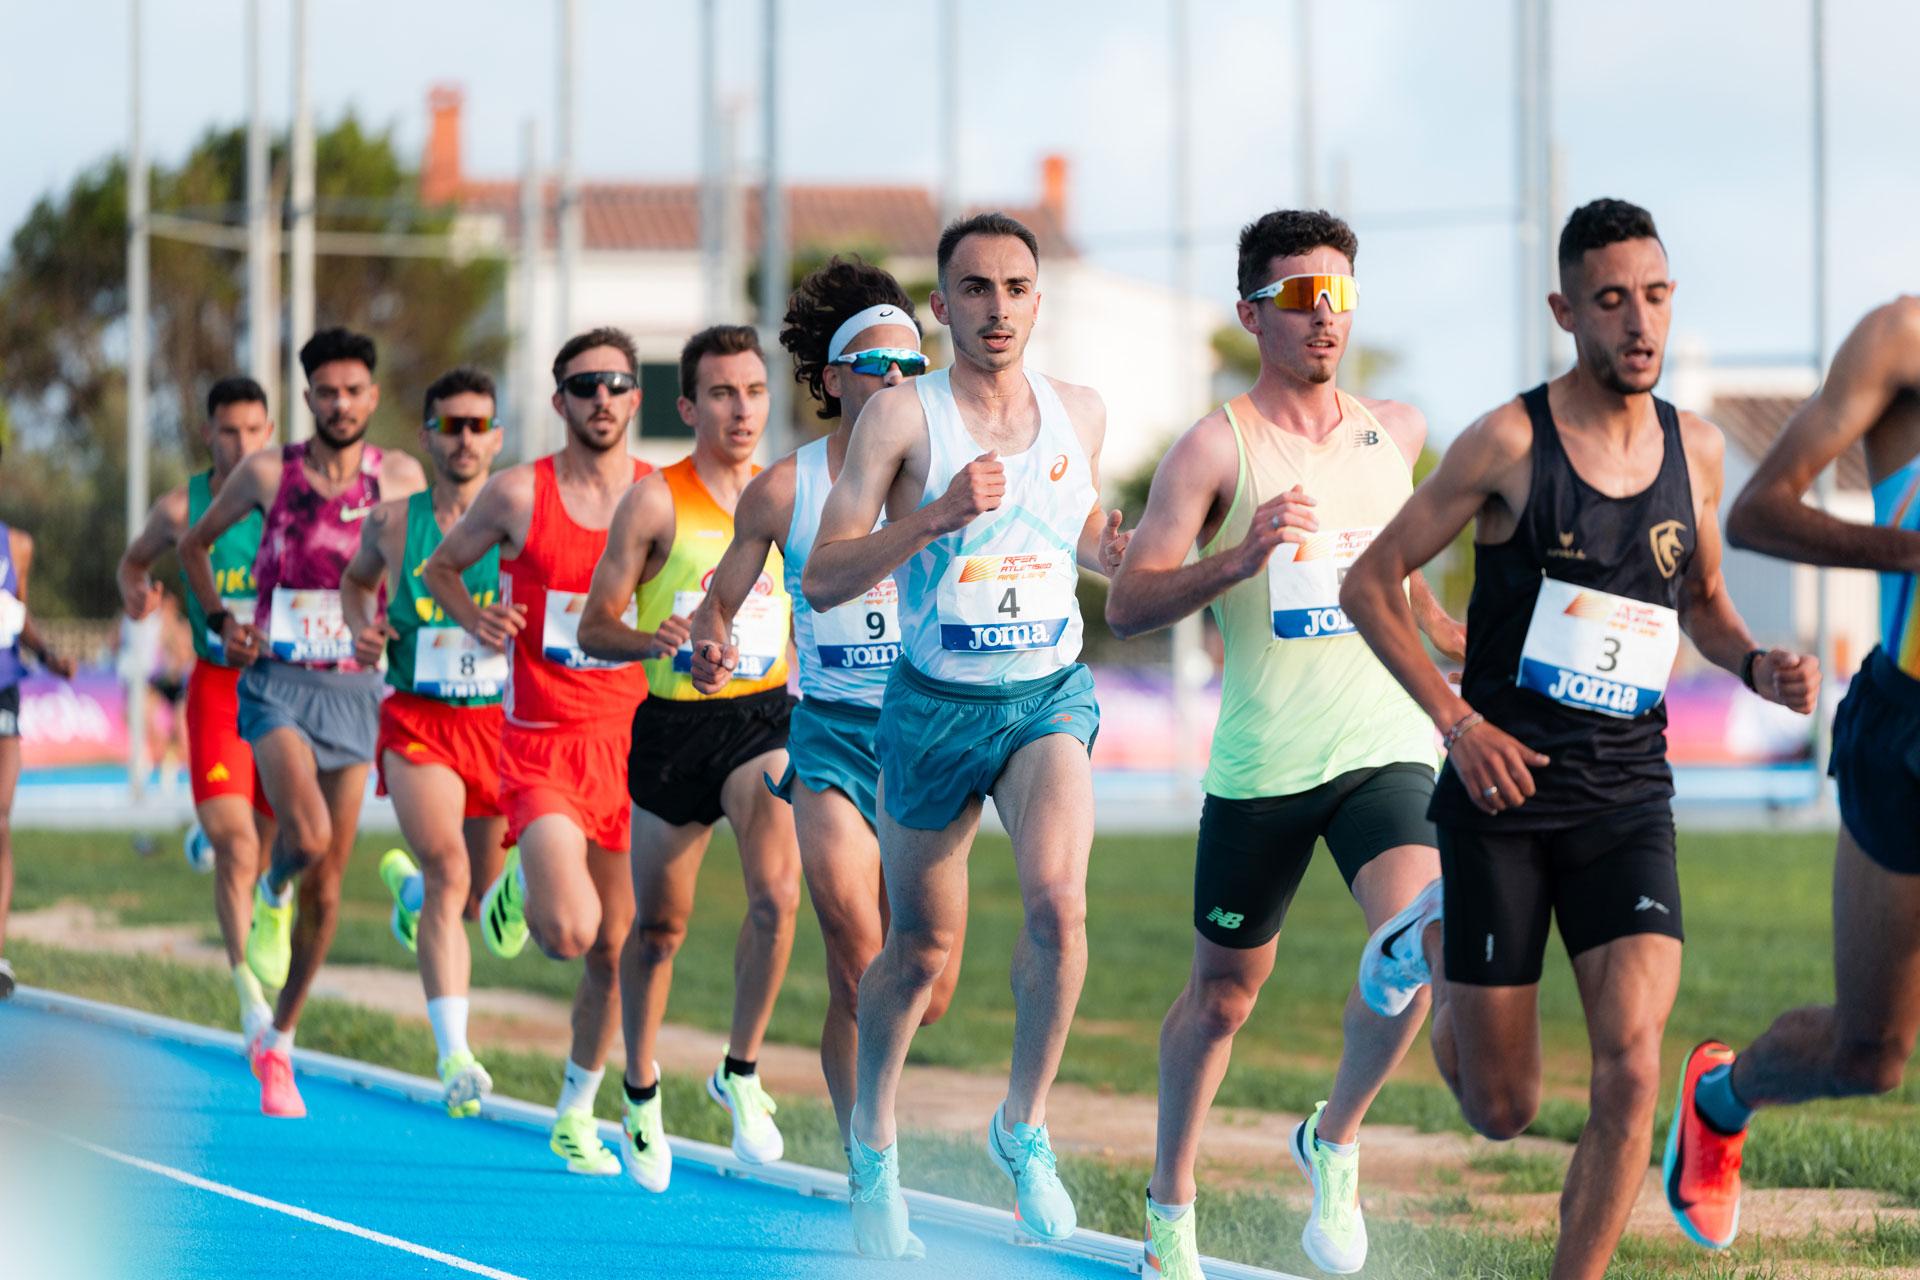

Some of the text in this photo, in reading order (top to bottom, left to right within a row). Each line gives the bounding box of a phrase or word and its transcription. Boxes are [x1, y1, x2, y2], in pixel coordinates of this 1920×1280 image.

[997, 587, 1021, 619] 4
[865, 611, 886, 640] 9
[460, 653, 475, 676] 8
[841, 644, 900, 668] Jom
[1595, 637, 1621, 672] 3
